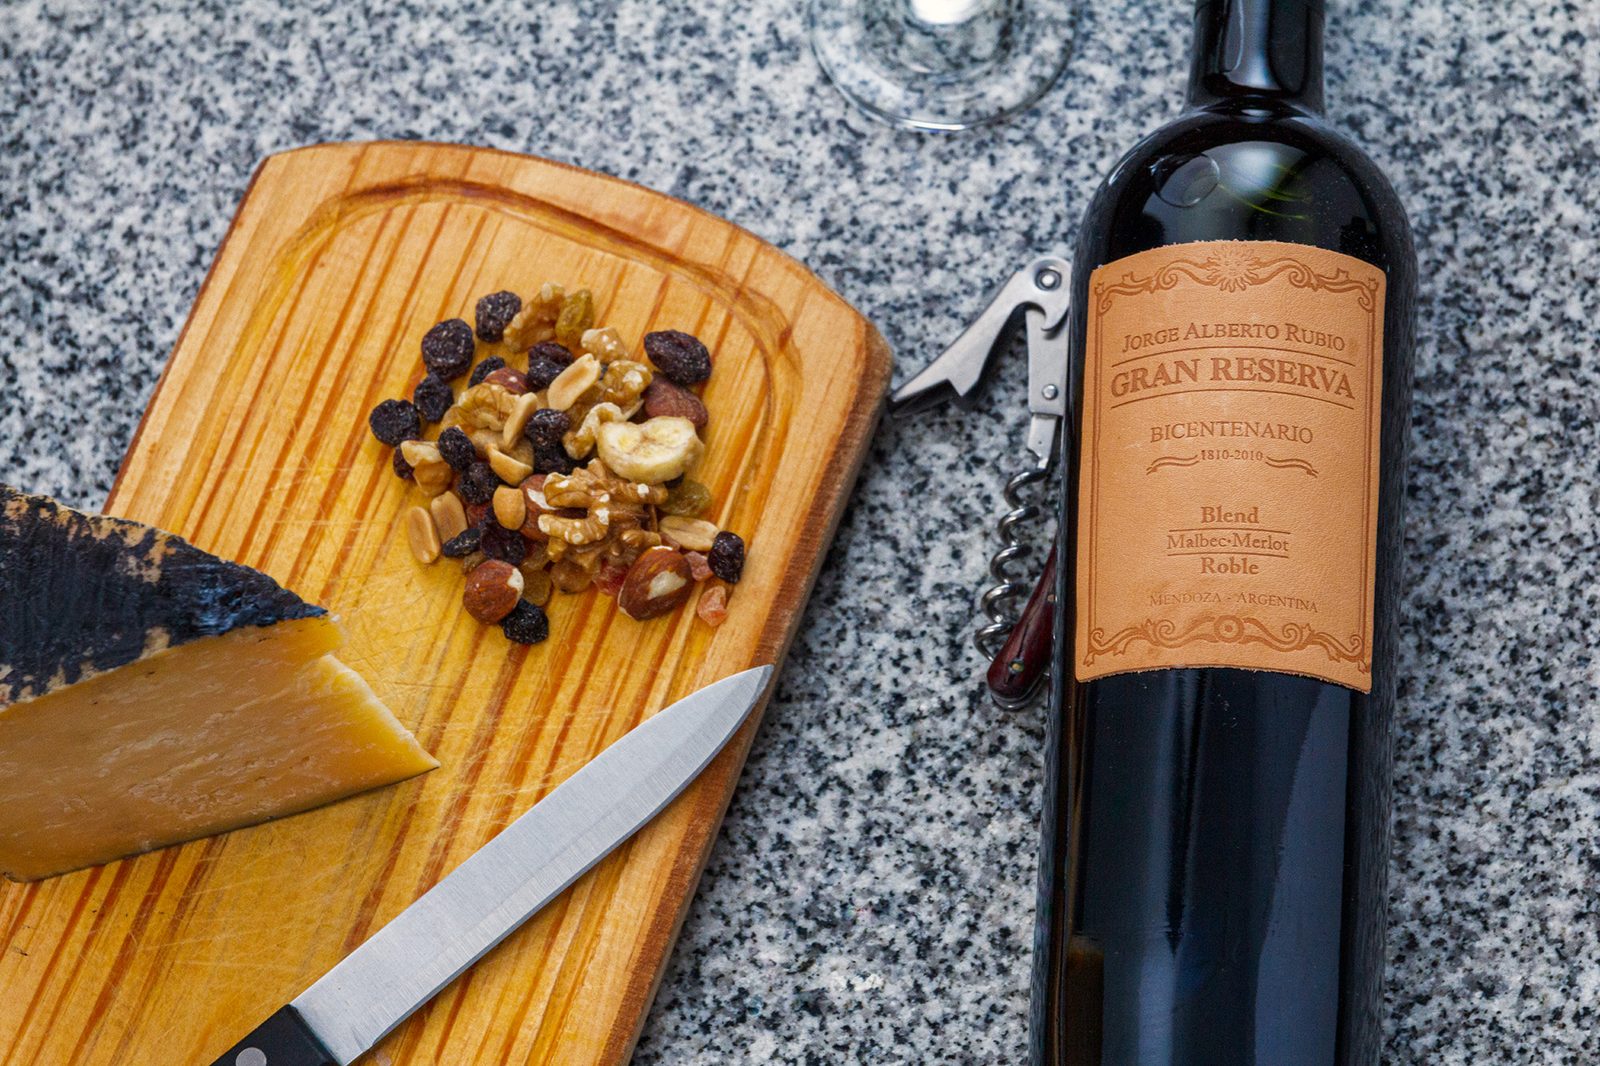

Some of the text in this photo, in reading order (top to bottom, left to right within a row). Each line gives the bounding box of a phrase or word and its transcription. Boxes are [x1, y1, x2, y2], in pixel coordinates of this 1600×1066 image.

[1122, 322, 1345, 353] JORGE ALBERTO RUBIO
[1111, 357, 1355, 400] GRAN RESERVA
[1150, 421, 1314, 444] BICENTENARIO
[1201, 450, 1263, 462] 1810-2010
[1200, 506, 1260, 524] Blend
[1200, 557, 1259, 575] Roble
[1149, 592, 1222, 607] MENDOZA
[1234, 592, 1318, 613] ARGENTINA
